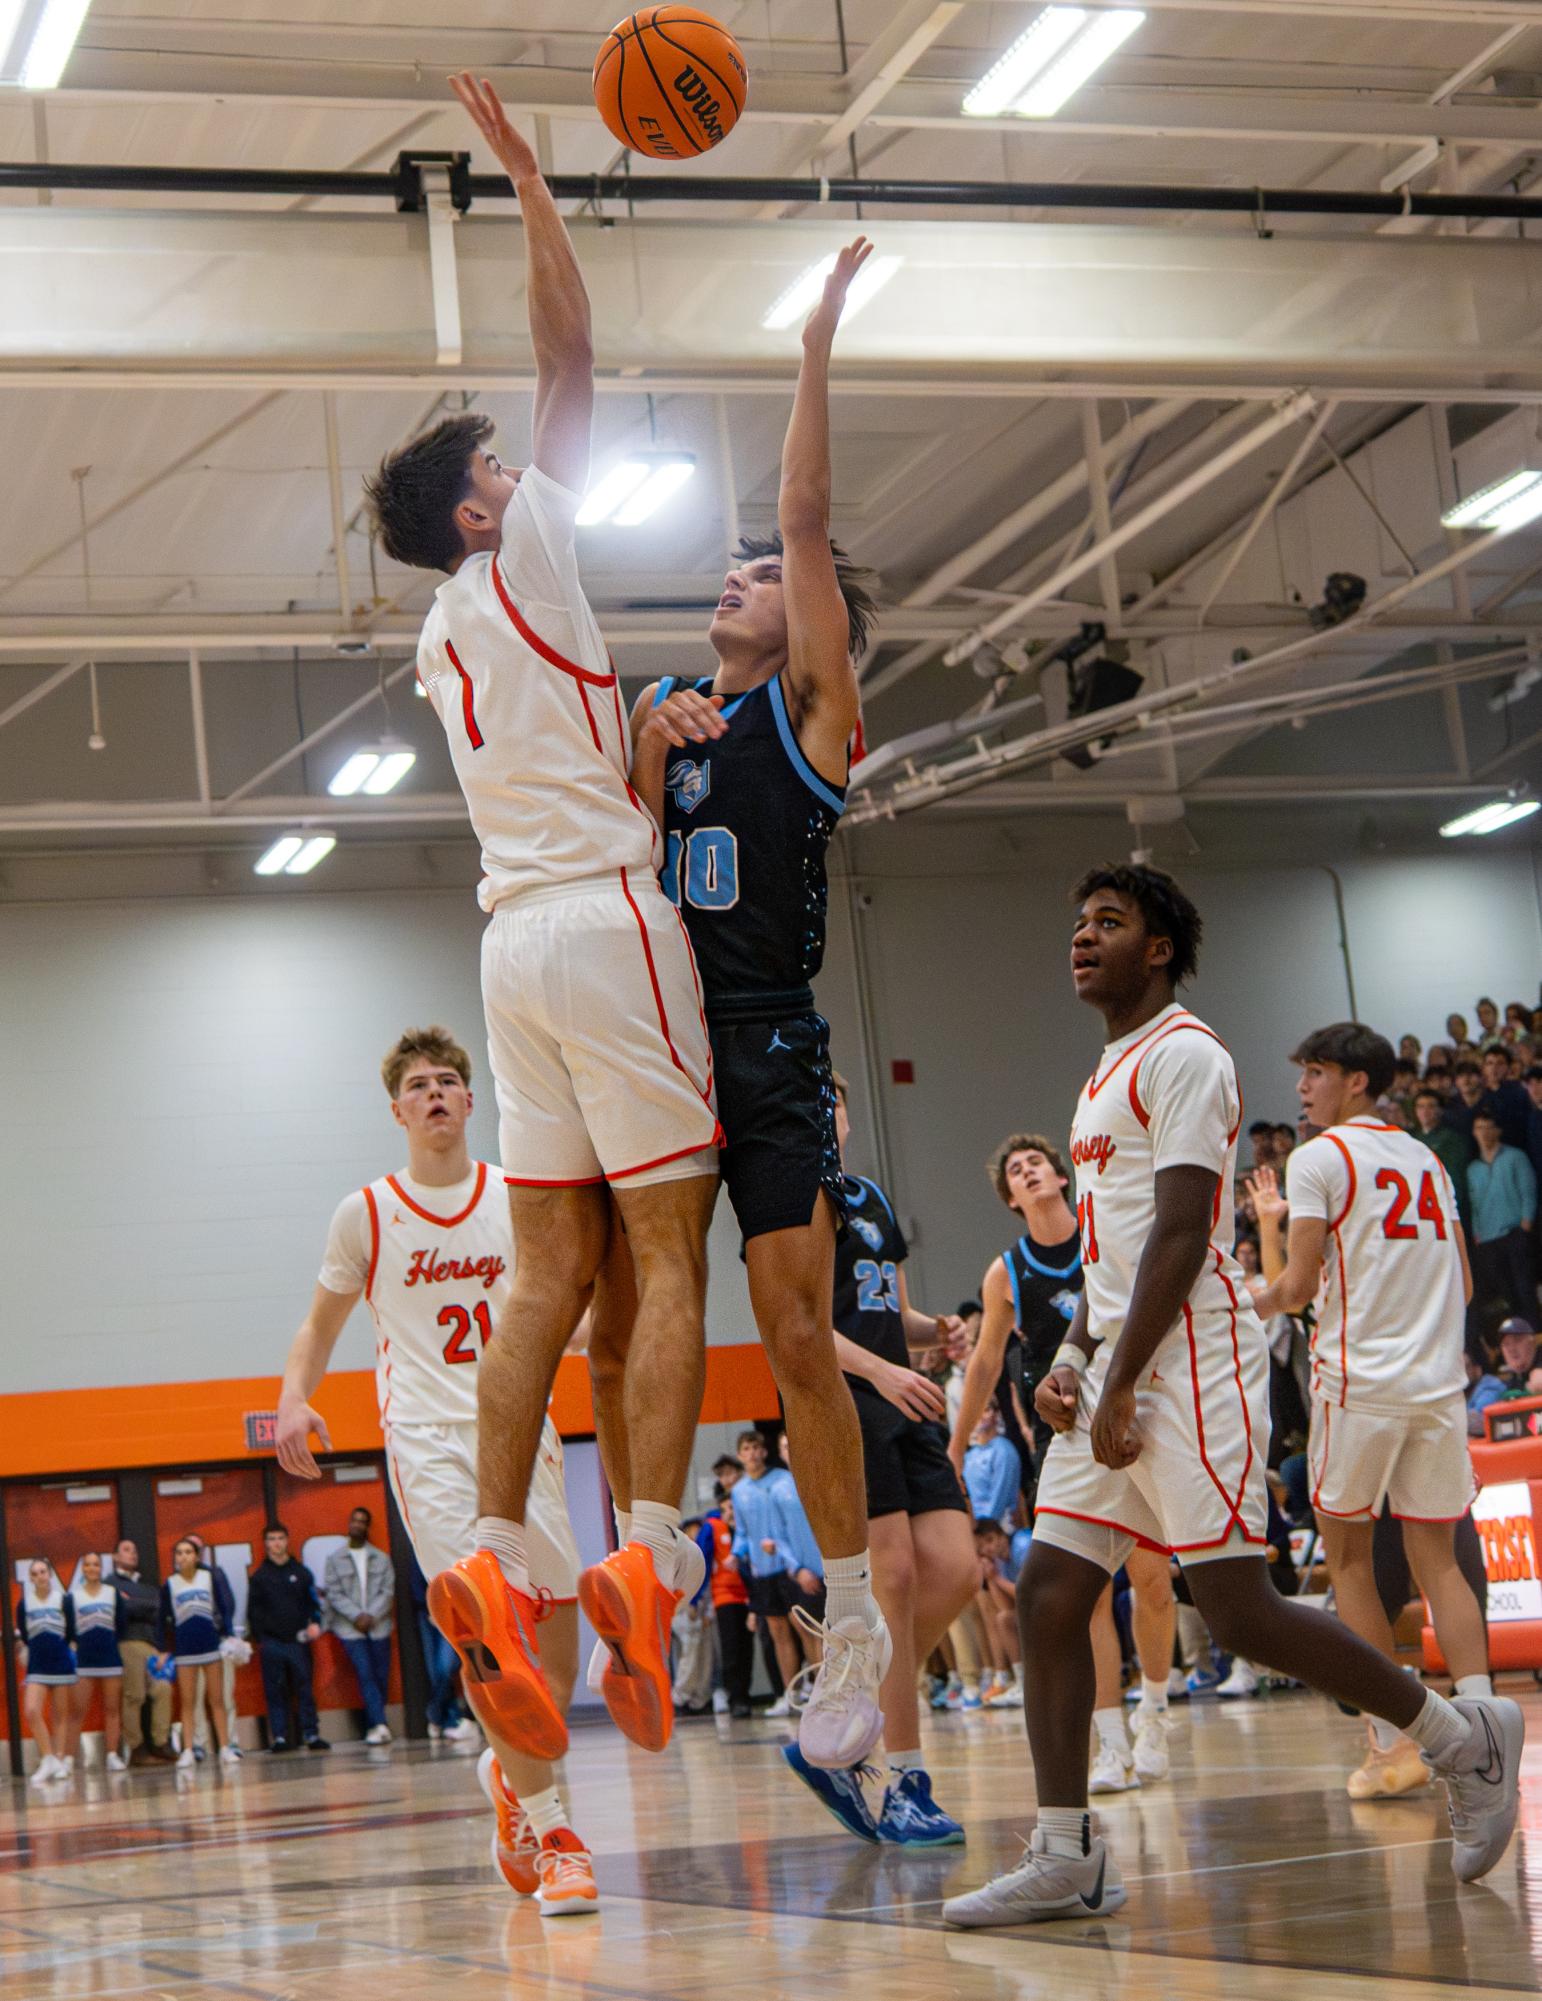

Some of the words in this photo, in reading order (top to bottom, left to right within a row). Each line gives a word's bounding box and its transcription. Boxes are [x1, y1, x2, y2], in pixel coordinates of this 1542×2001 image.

[674, 64, 725, 147] Wilson
[445, 638, 485, 752] 1
[1070, 1127, 1117, 1175] ersey
[1375, 1168, 1448, 1241] 24
[404, 1248, 506, 1288] Hersey
[853, 1259, 900, 1313] 23
[437, 1300, 493, 1365] 21
[255, 1418, 277, 1442] EX
[1486, 1591, 1522, 1611] CHOOL
